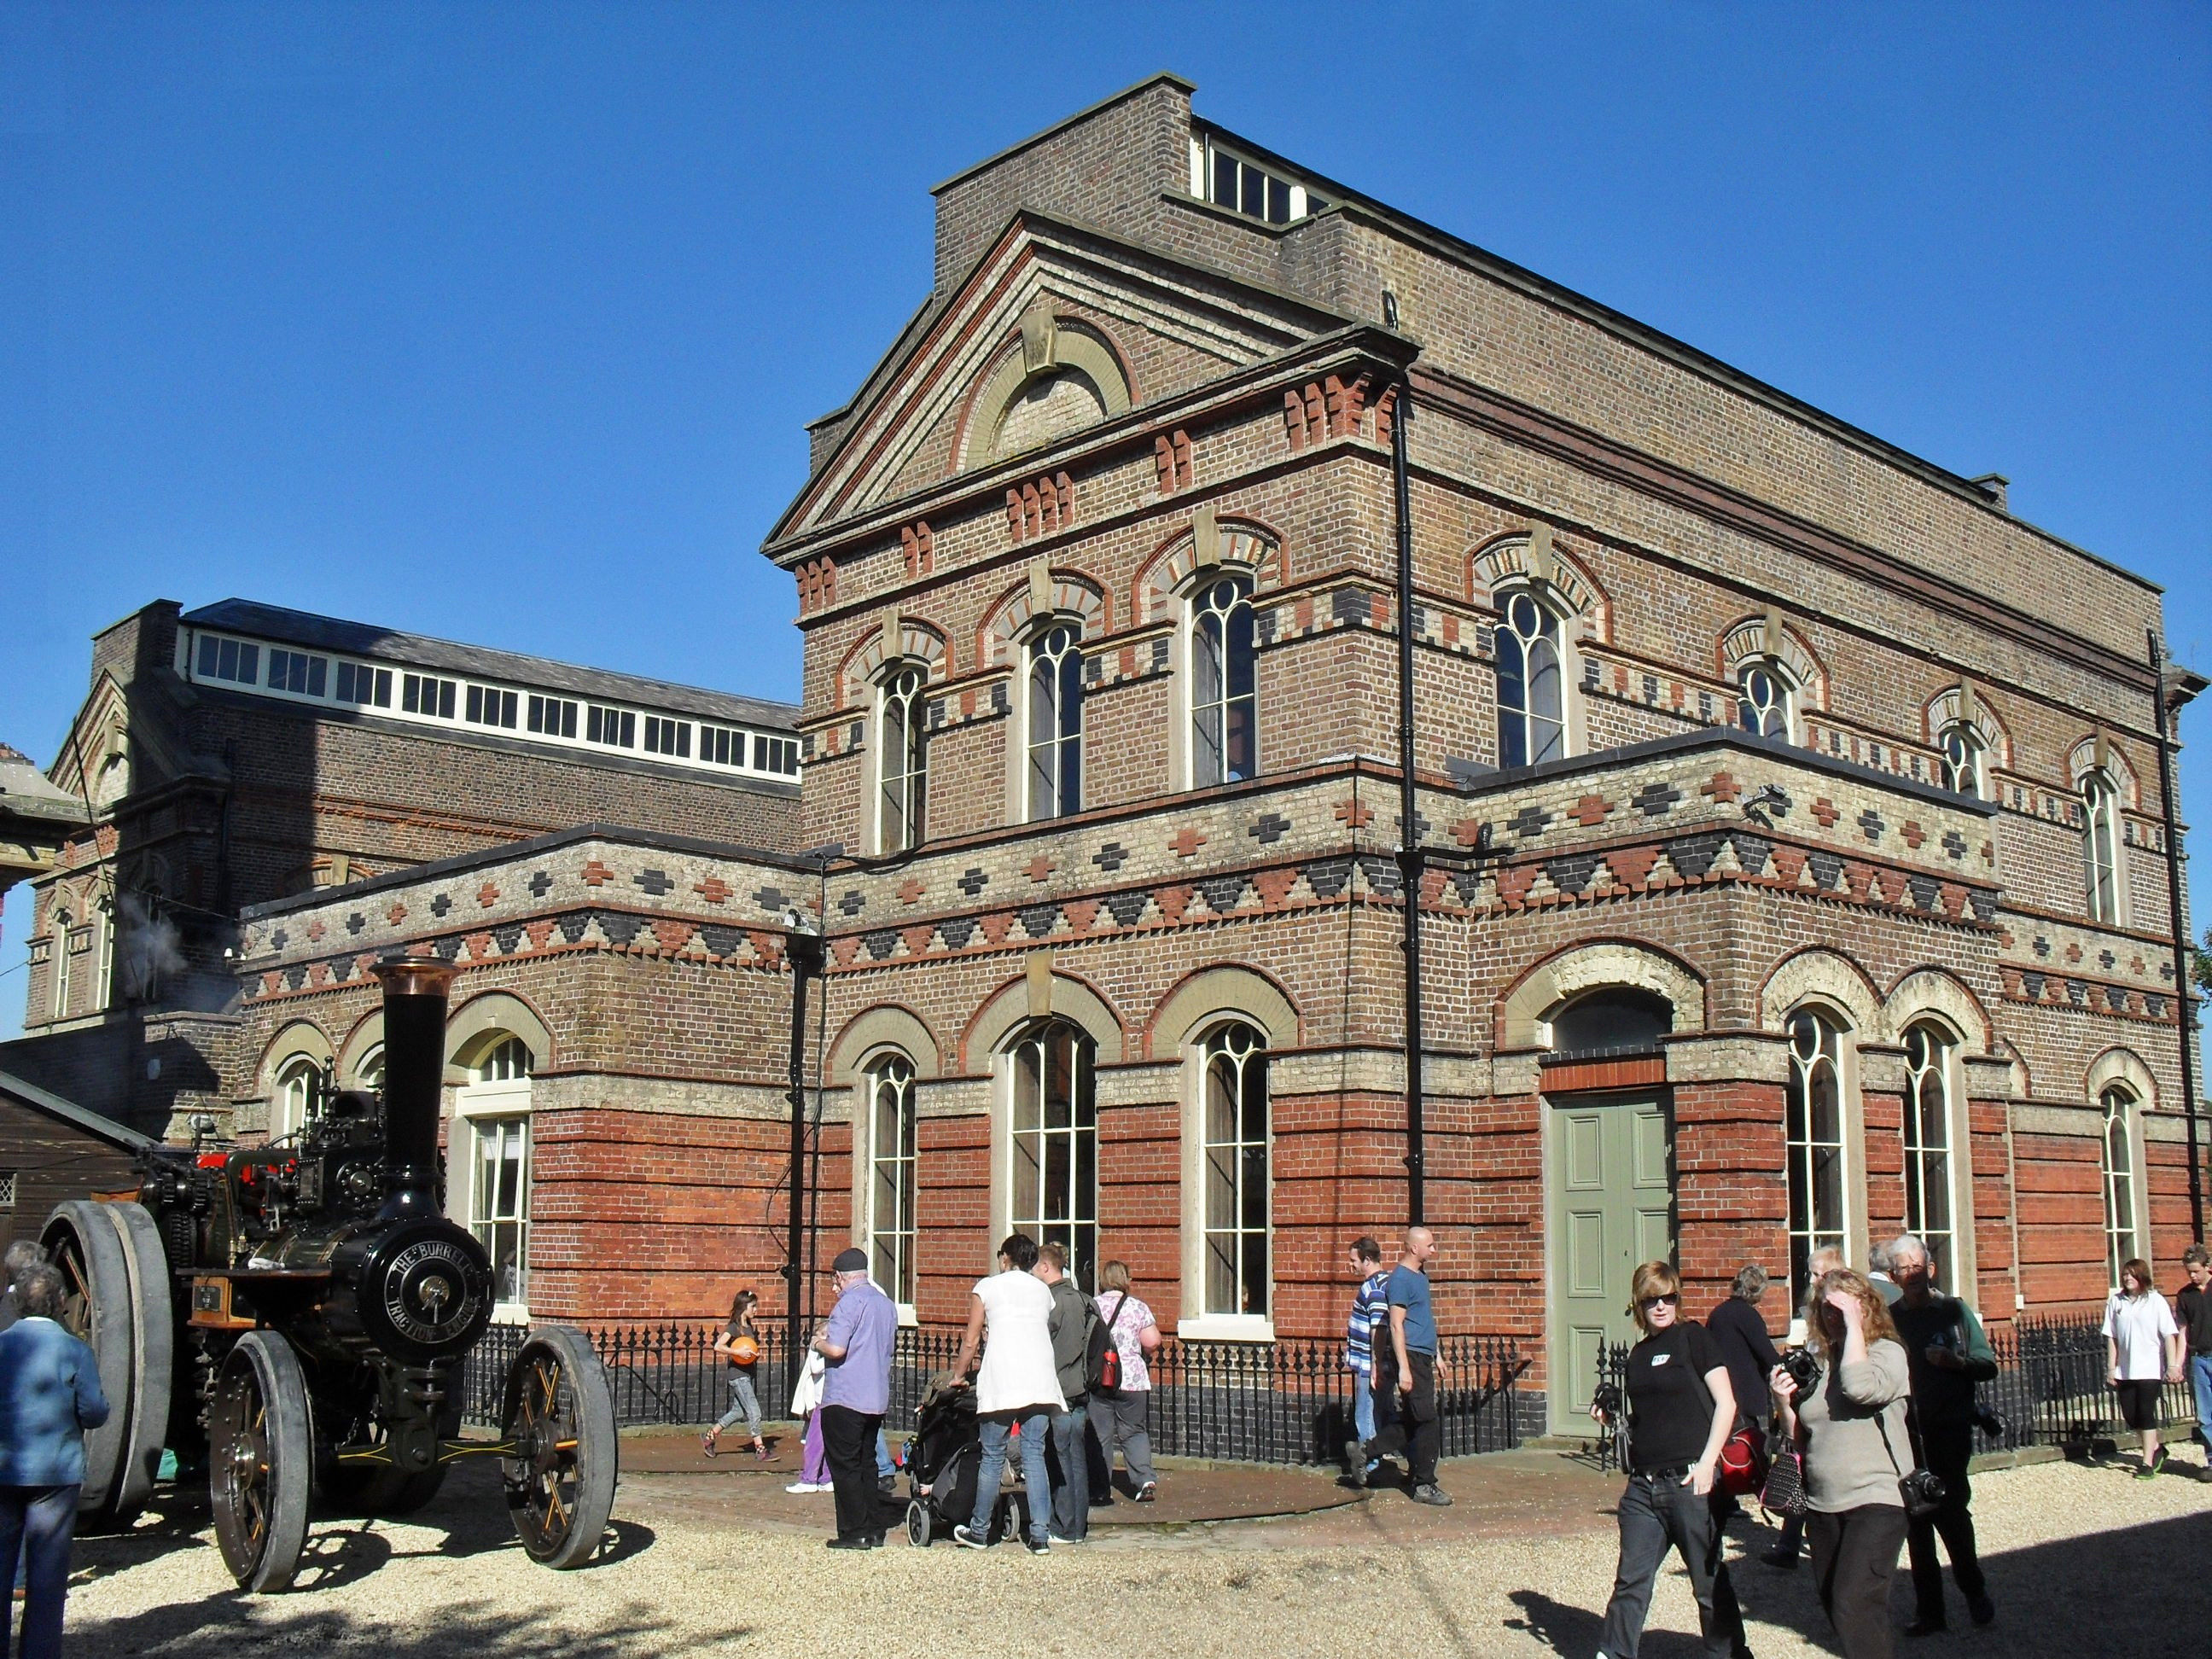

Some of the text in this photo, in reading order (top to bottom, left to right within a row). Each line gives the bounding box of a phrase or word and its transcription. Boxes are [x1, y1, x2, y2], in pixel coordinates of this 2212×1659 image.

[393, 1252, 416, 1274] THE
[388, 1295, 480, 1341] TRACTION ENGINE
